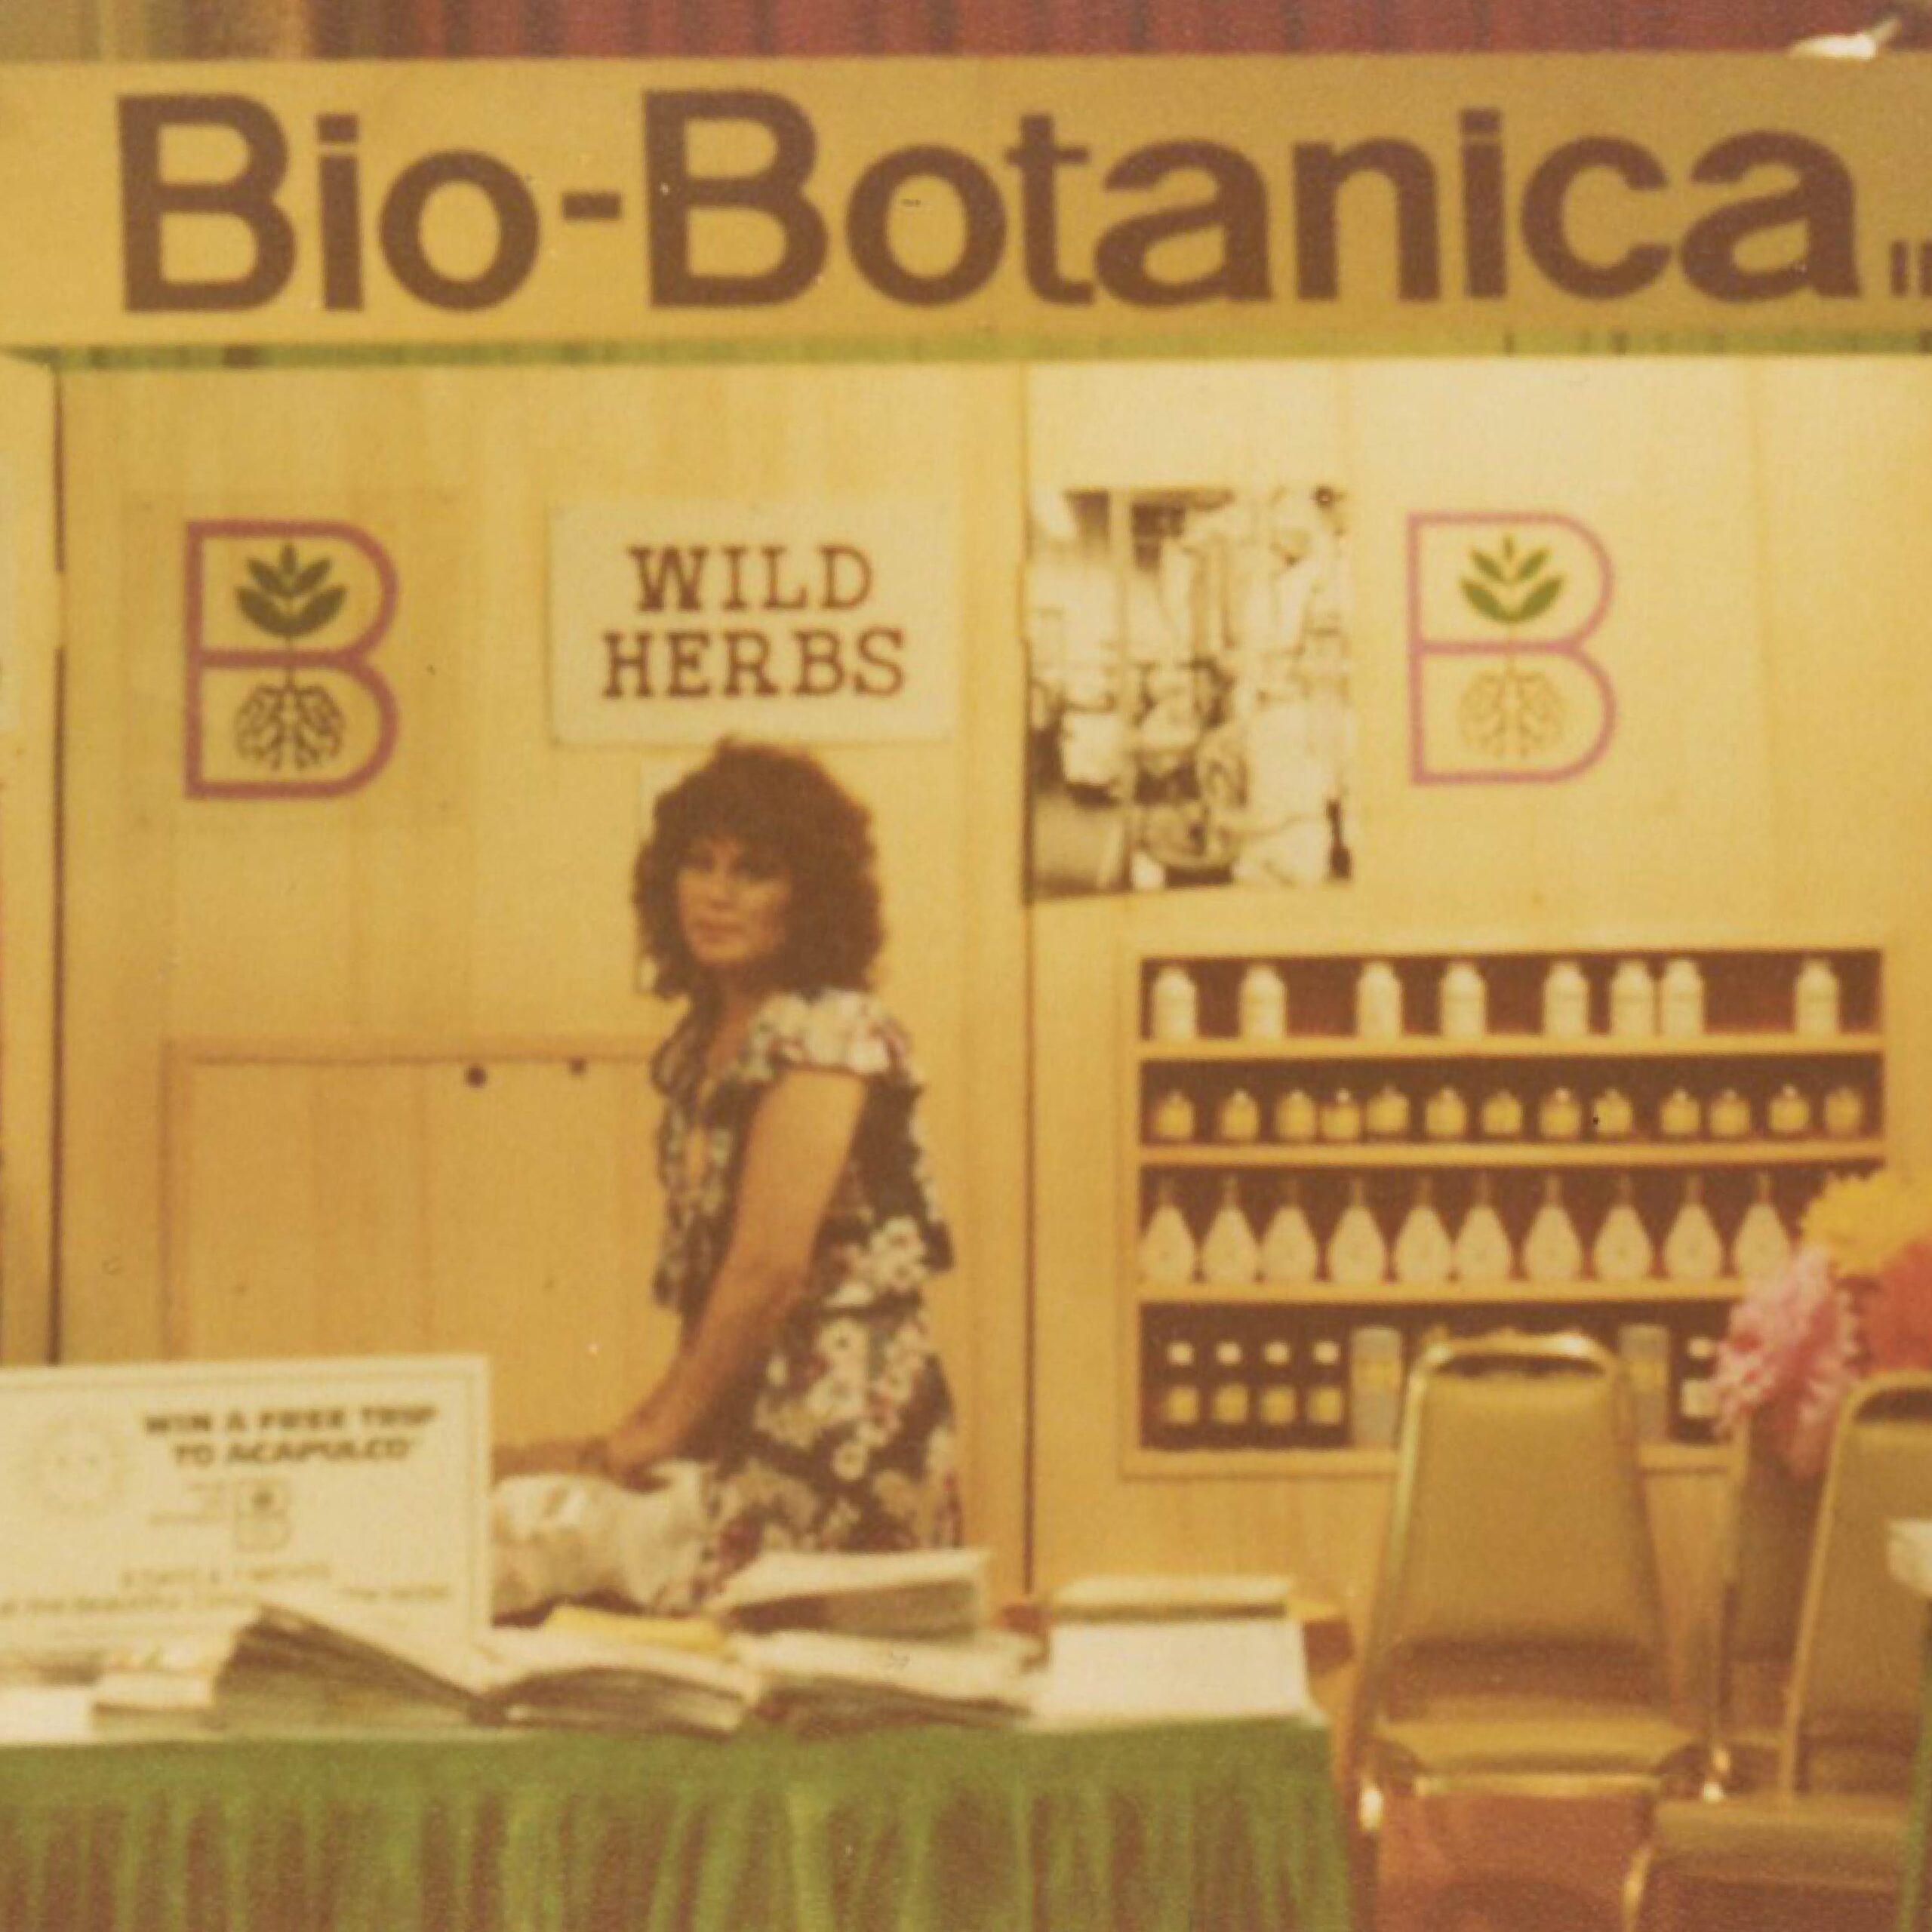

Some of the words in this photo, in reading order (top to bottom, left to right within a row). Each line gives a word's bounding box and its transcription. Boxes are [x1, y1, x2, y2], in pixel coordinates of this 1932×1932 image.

[115, 88, 1861, 312] Bio-Botanica
[628, 543, 874, 612] WILD
[601, 626, 906, 698] HERBS
[146, 1412, 212, 1435] WIN
[226, 1411, 248, 1432] A
[260, 1406, 346, 1430] FREE
[174, 1441, 214, 1466] TO
[227, 1437, 413, 1463] ACAPULCO
